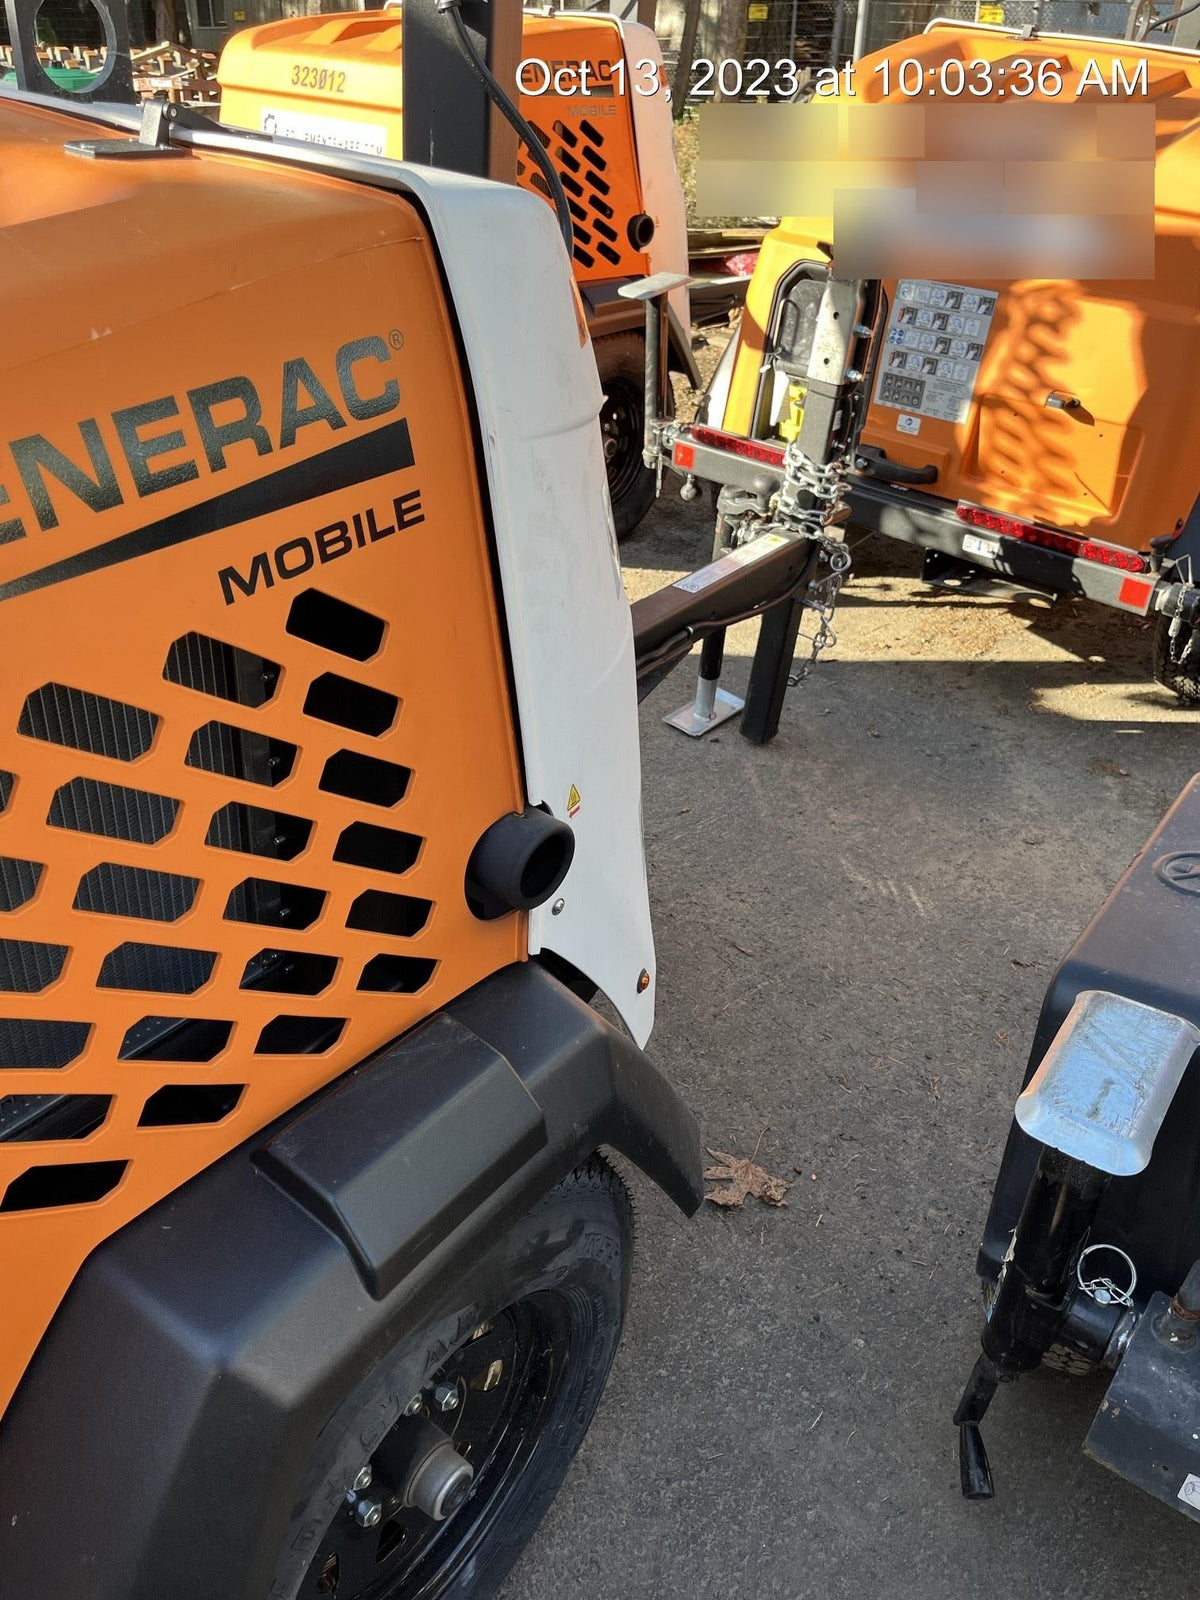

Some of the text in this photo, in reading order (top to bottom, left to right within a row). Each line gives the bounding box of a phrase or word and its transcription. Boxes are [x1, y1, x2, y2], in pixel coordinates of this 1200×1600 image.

[291, 64, 347, 93] 323012
[566, 104, 617, 117] MOBILE
[217, 489, 426, 606] MOBILE
